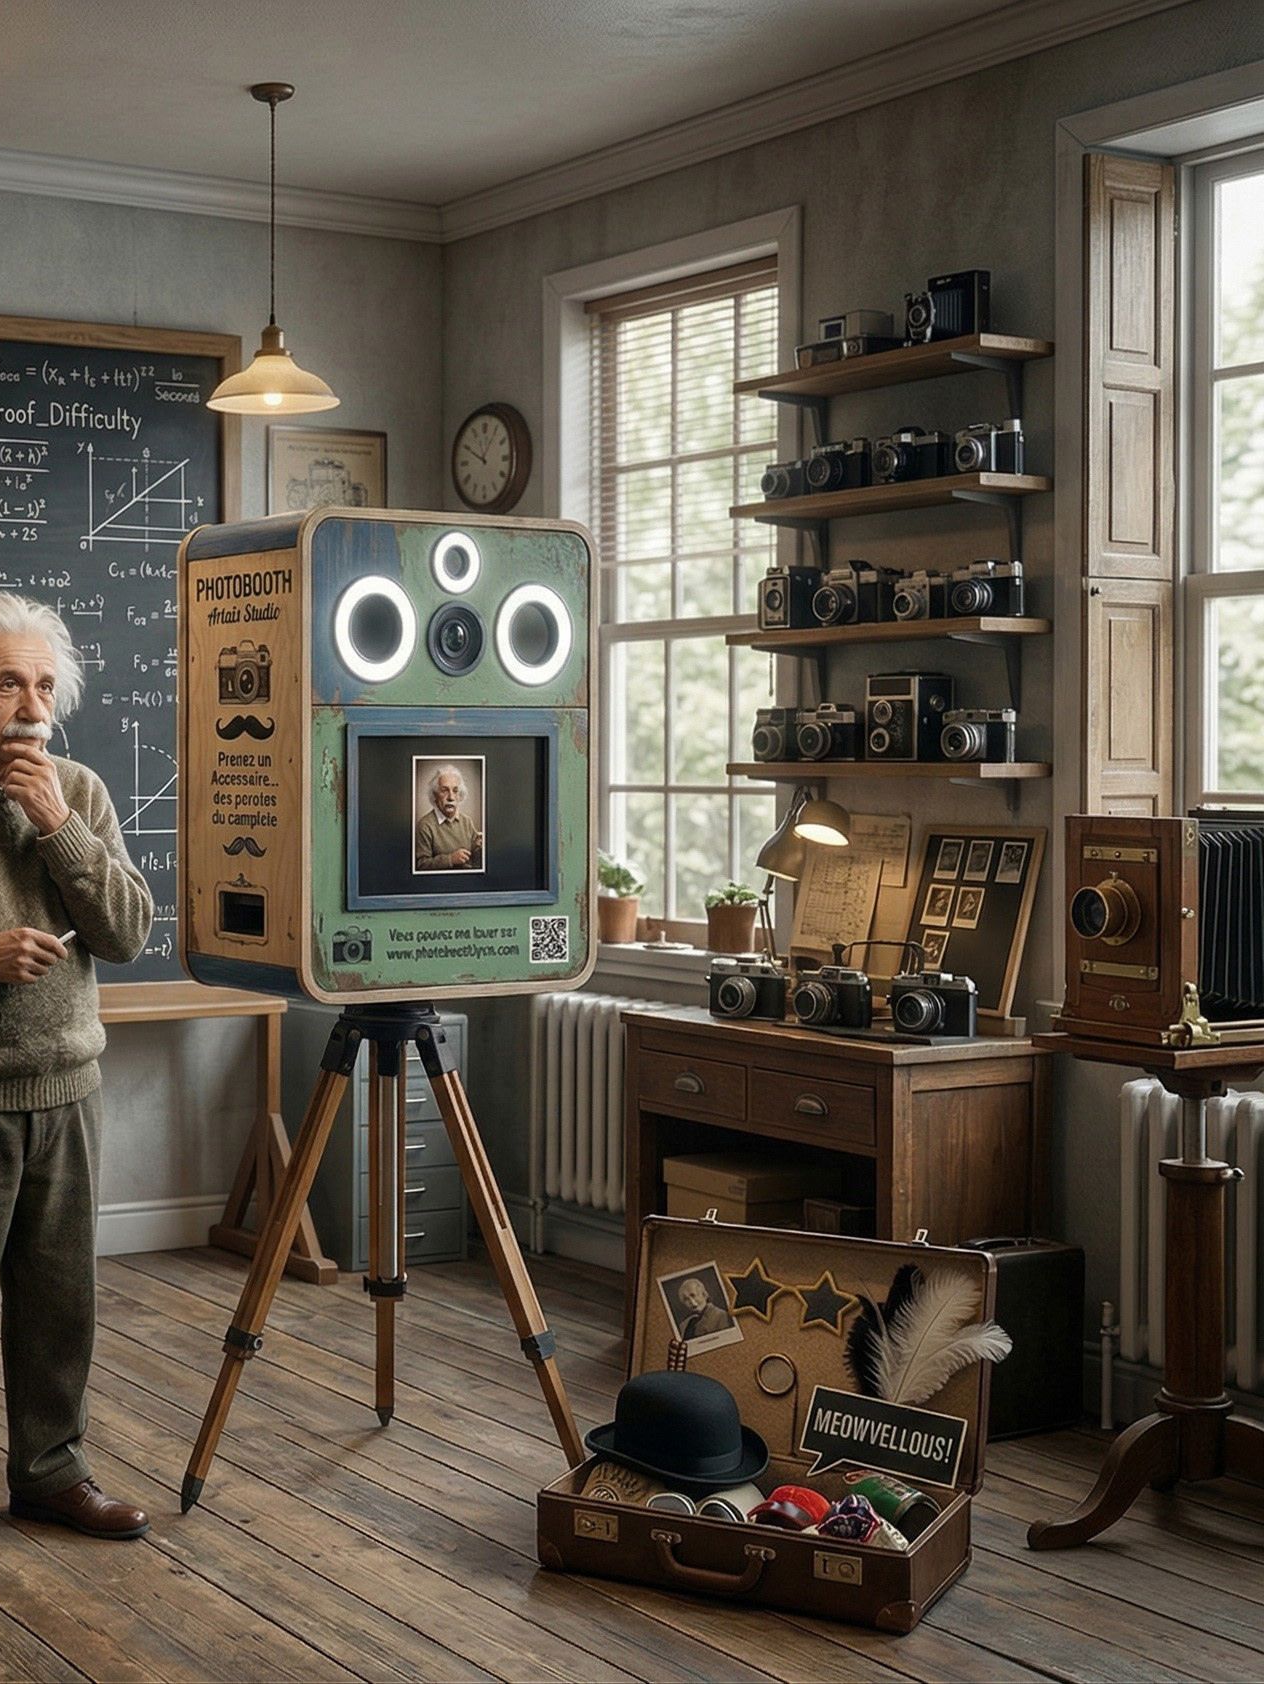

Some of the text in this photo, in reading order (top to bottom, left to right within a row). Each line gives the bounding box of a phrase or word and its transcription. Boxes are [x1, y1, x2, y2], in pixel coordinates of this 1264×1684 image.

[196, 569, 292, 602] PHOTOBOOTH
[243, 602, 281, 622] Studio
[218, 751, 271, 767] Prenez un
[213, 790, 232, 805] des
[212, 809, 225, 825] du
[813, 1407, 954, 1464] MEOWVELLOUS!
